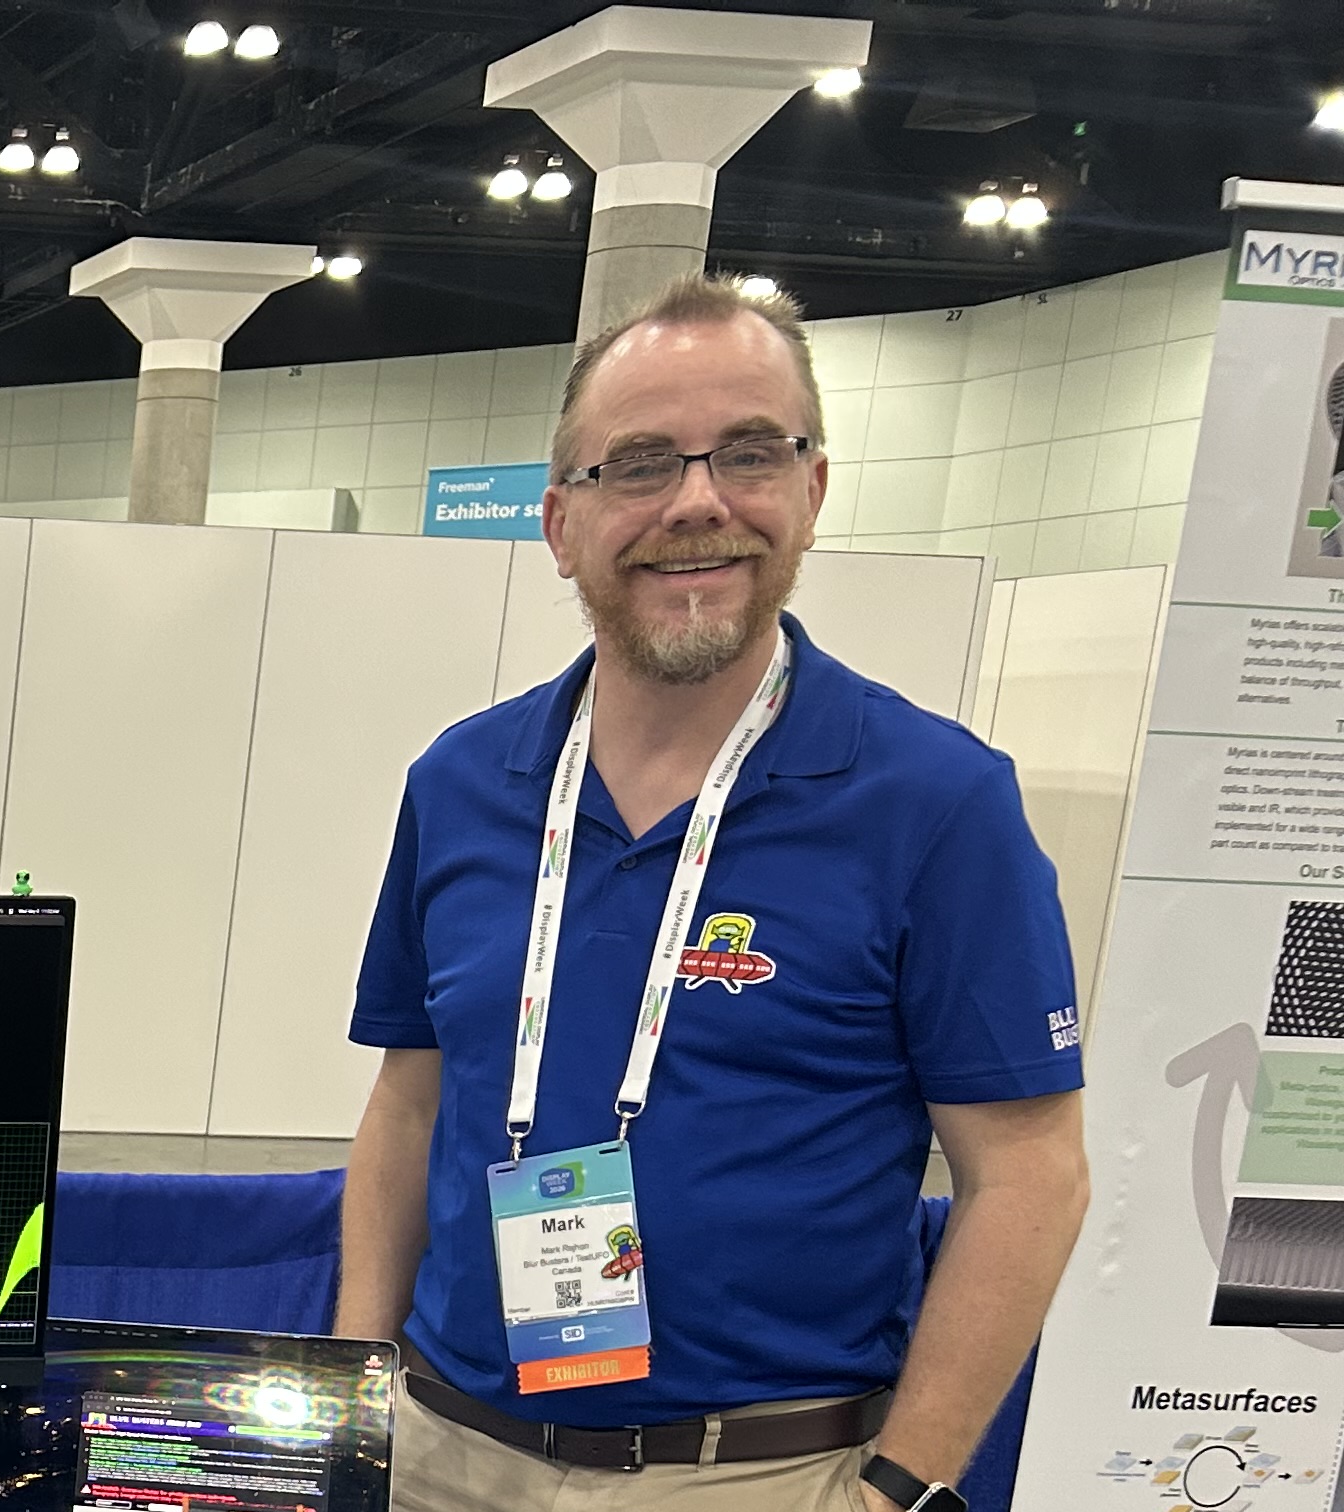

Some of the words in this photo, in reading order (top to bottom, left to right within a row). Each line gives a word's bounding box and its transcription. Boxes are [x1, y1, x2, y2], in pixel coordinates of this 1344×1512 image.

[945, 309, 963, 323] 27
[438, 481, 490, 493] Freeman
[435, 501, 520, 521] Exhibitor
[1300, 864, 1329, 878] Our
[542, 1215, 585, 1233] Mark
[541, 1257, 569, 1267] Busters
[576, 1251, 609, 1261] TestUFO
[552, 1266, 581, 1275] Canada
[564, 1329, 582, 1339] SID
[546, 1360, 620, 1383] EXHIBITOR
[1131, 1385, 1318, 1413] Metasurfaces
